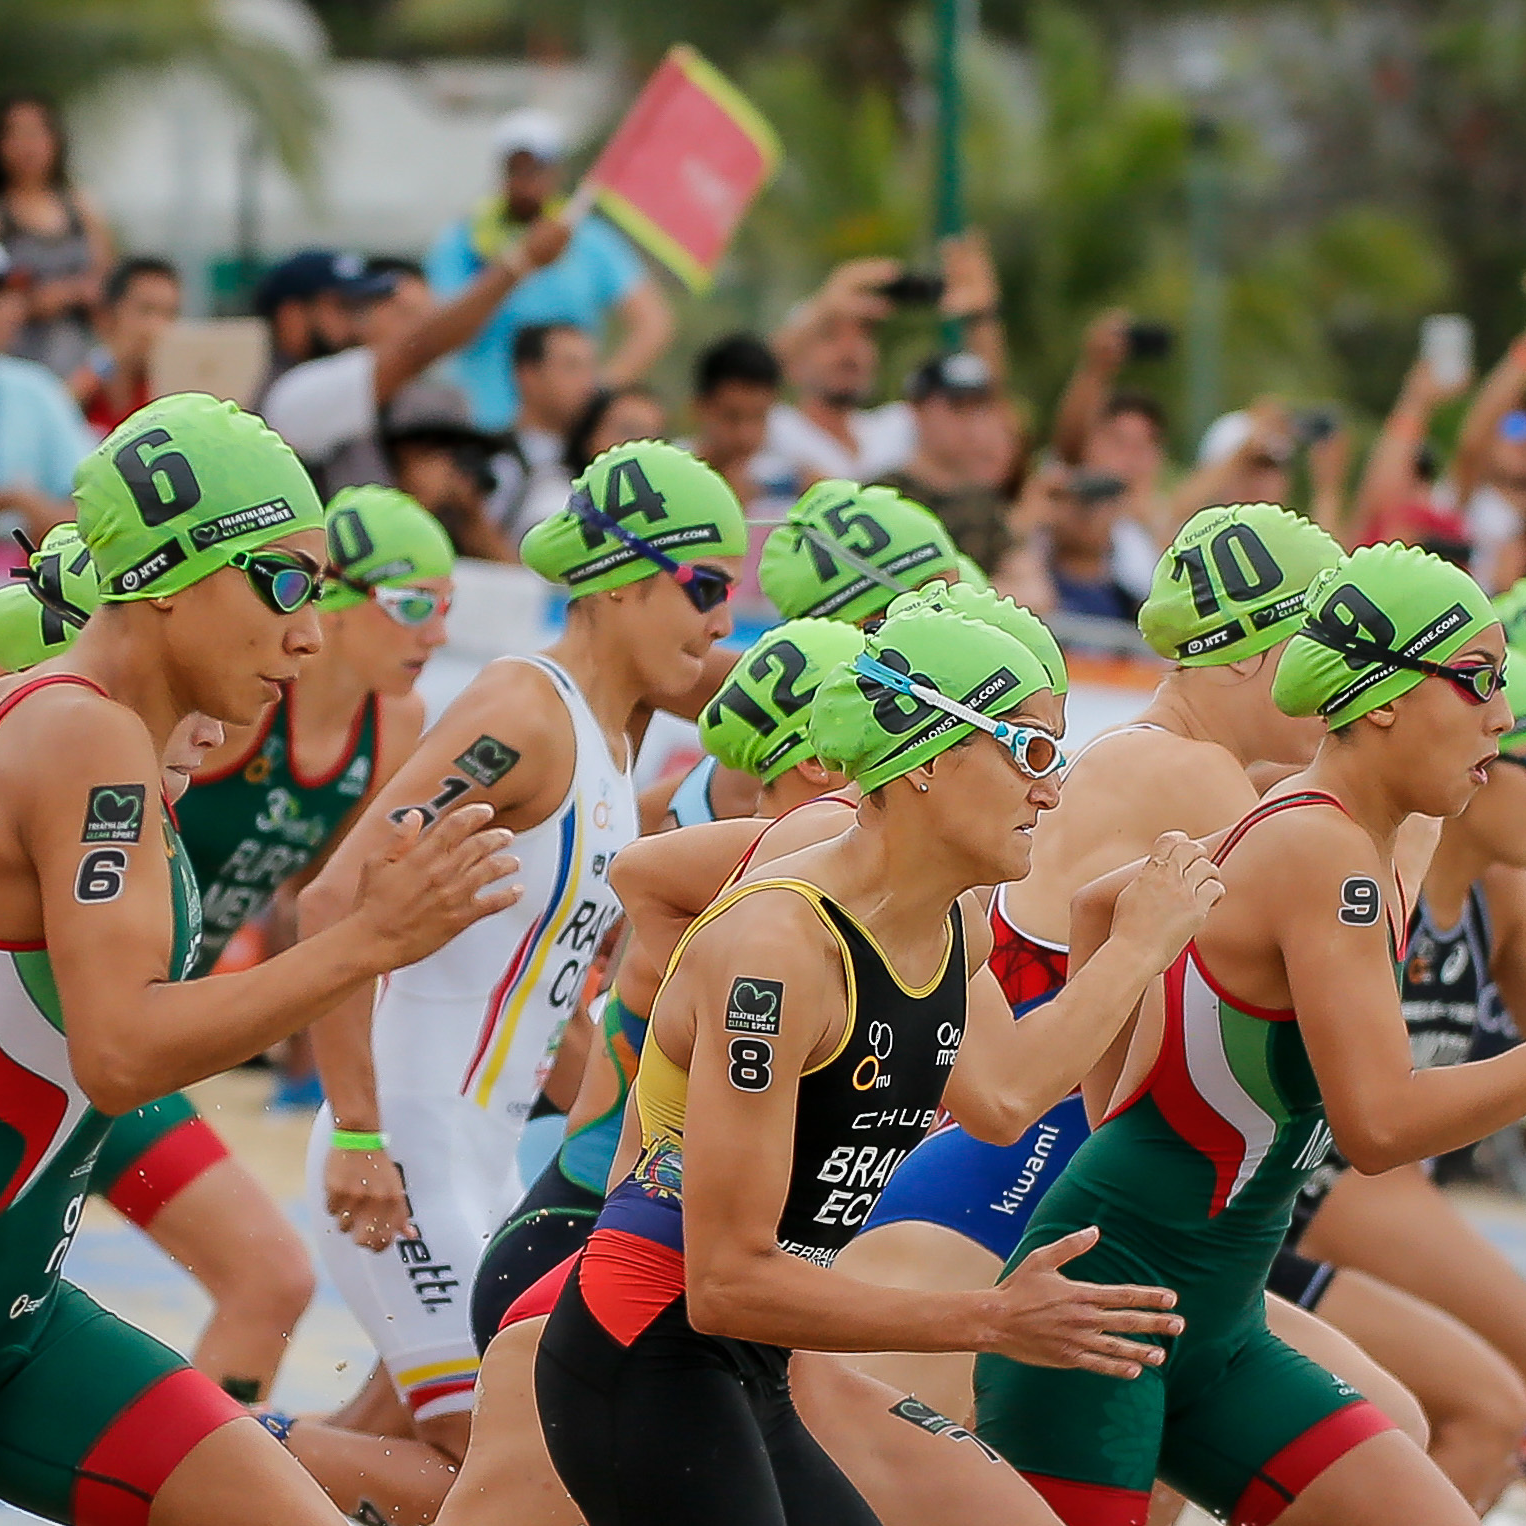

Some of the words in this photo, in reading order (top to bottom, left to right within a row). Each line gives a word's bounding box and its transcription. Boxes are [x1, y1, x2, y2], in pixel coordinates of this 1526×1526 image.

[115, 428, 202, 527] 6
[138, 553, 169, 580] NTT
[793, 499, 891, 584] 15
[1171, 522, 1285, 619] 10
[1203, 630, 1229, 648] NTT
[1318, 583, 1397, 671] 9
[707, 640, 823, 738] 12
[855, 648, 939, 735] 8
[74, 846, 128, 905] 6
[1337, 875, 1381, 927] 9
[728, 1036, 774, 1093] 8
[989, 1122, 1060, 1215] kiwami
